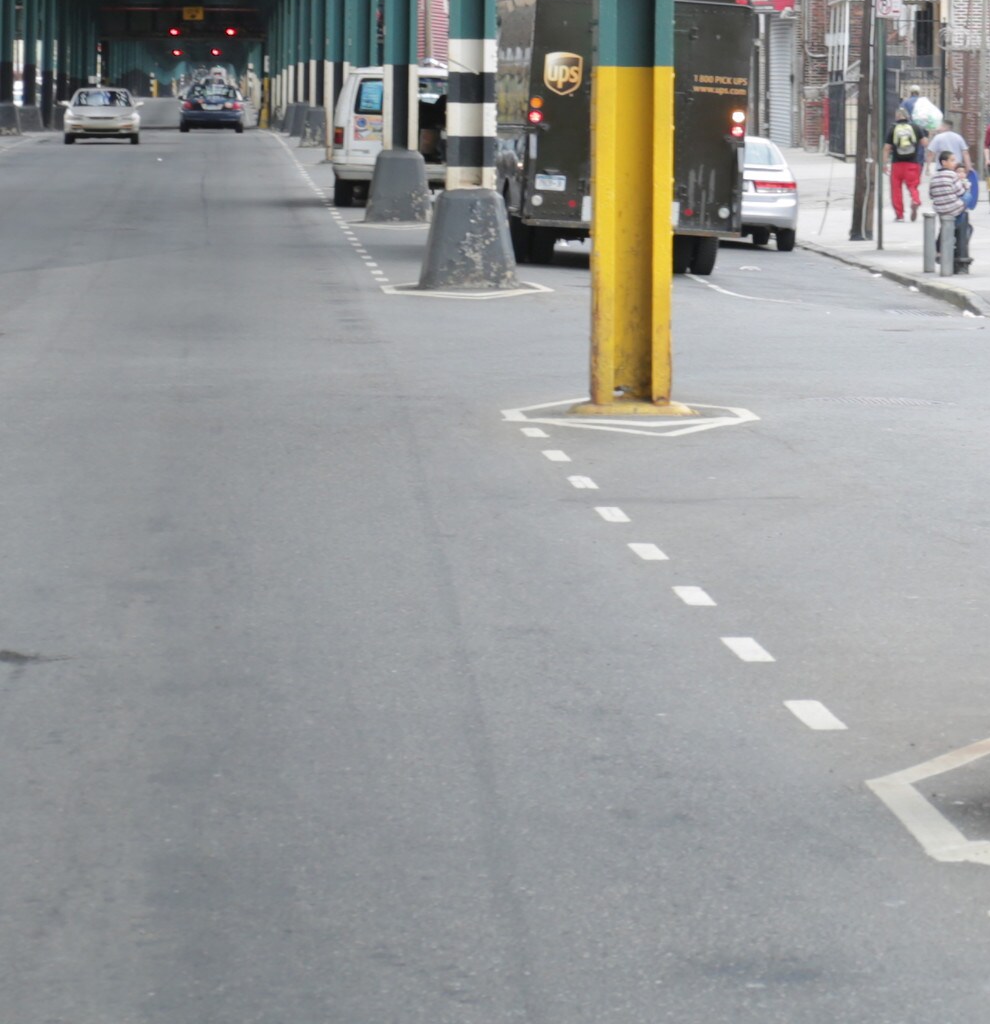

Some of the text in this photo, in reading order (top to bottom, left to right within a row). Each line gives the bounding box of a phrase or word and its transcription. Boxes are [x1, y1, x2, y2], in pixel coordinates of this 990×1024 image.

[547, 65, 580, 88] ups
[715, 76, 733, 86] PICK
[733, 77, 748, 87] UPS
[693, 85, 747, 96] www.ups.com
